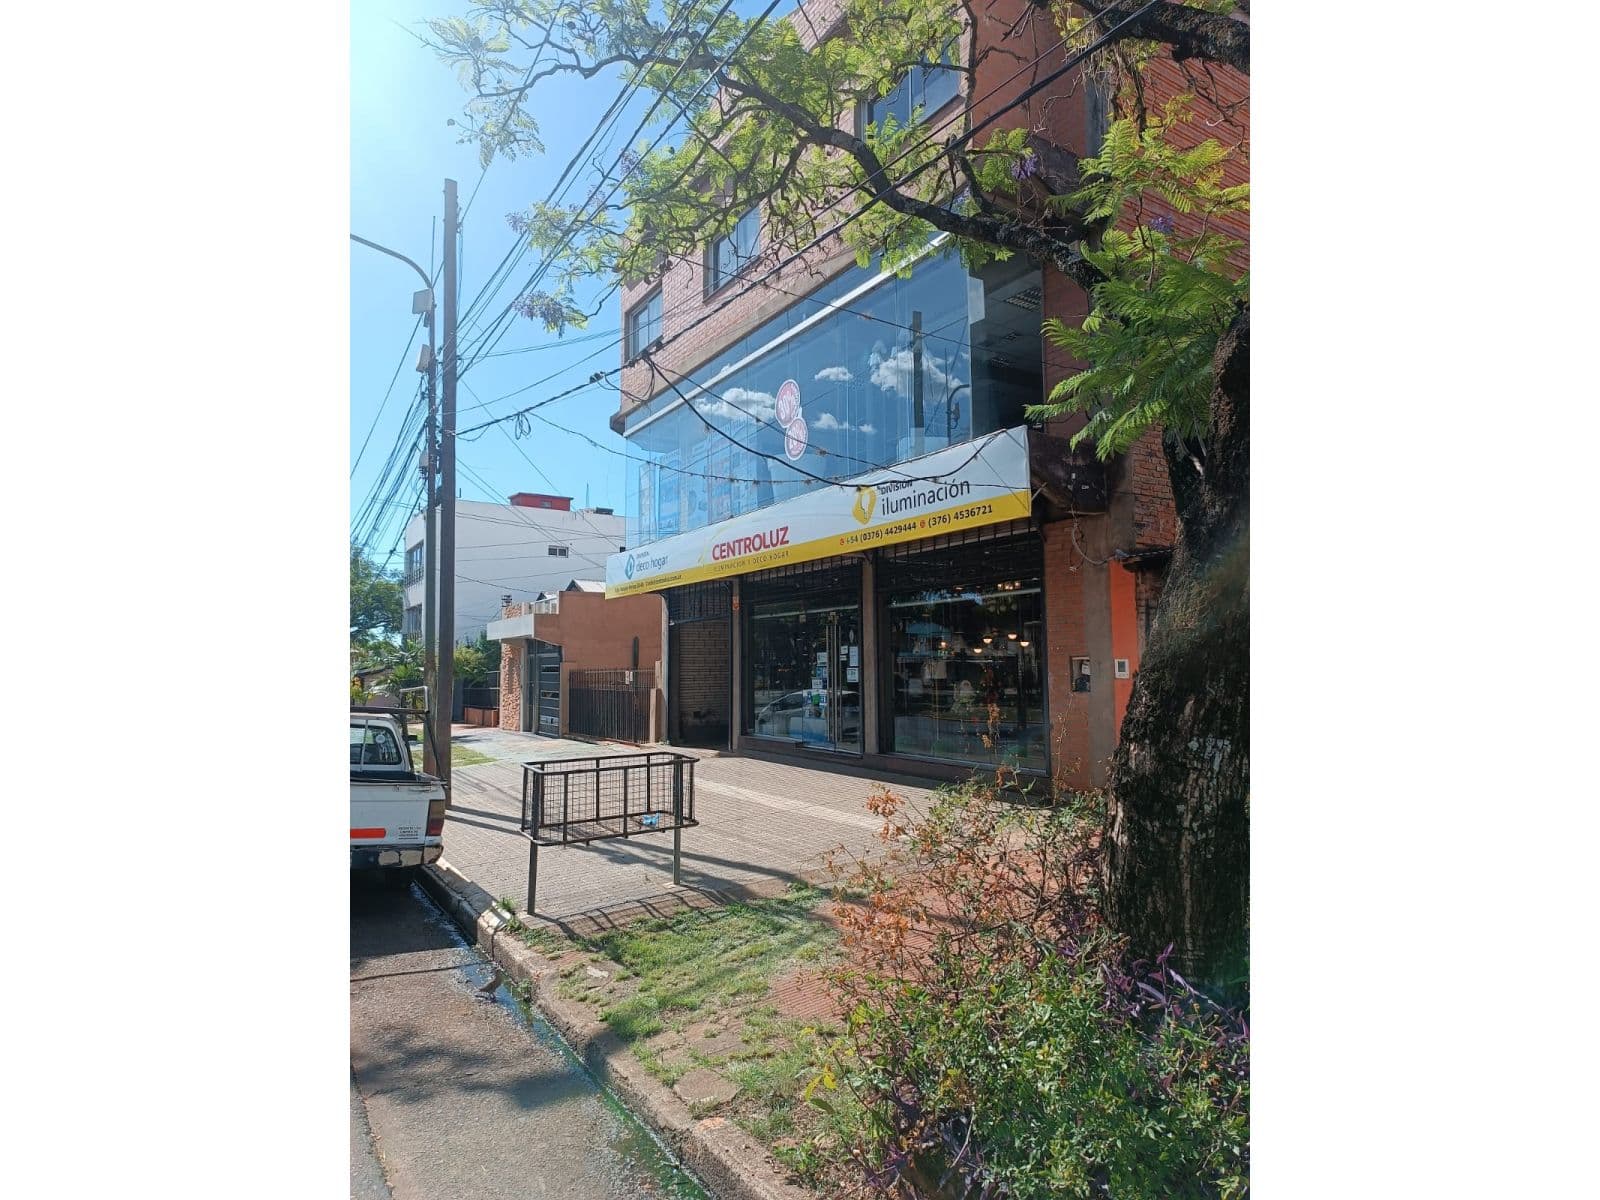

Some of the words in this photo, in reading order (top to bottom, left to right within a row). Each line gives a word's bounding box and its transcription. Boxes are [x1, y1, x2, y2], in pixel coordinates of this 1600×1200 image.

[881, 479, 970, 515] iluminación
[860, 528, 883, 542] (0376)
[885, 522, 917, 536] 4429444
[928, 513, 951, 528] (376)
[953, 504, 993, 521] 4536721
[712, 526, 789, 560] CENTROLUZ
[636, 561, 650, 572] deco
[650, 555, 669, 570] hogar
